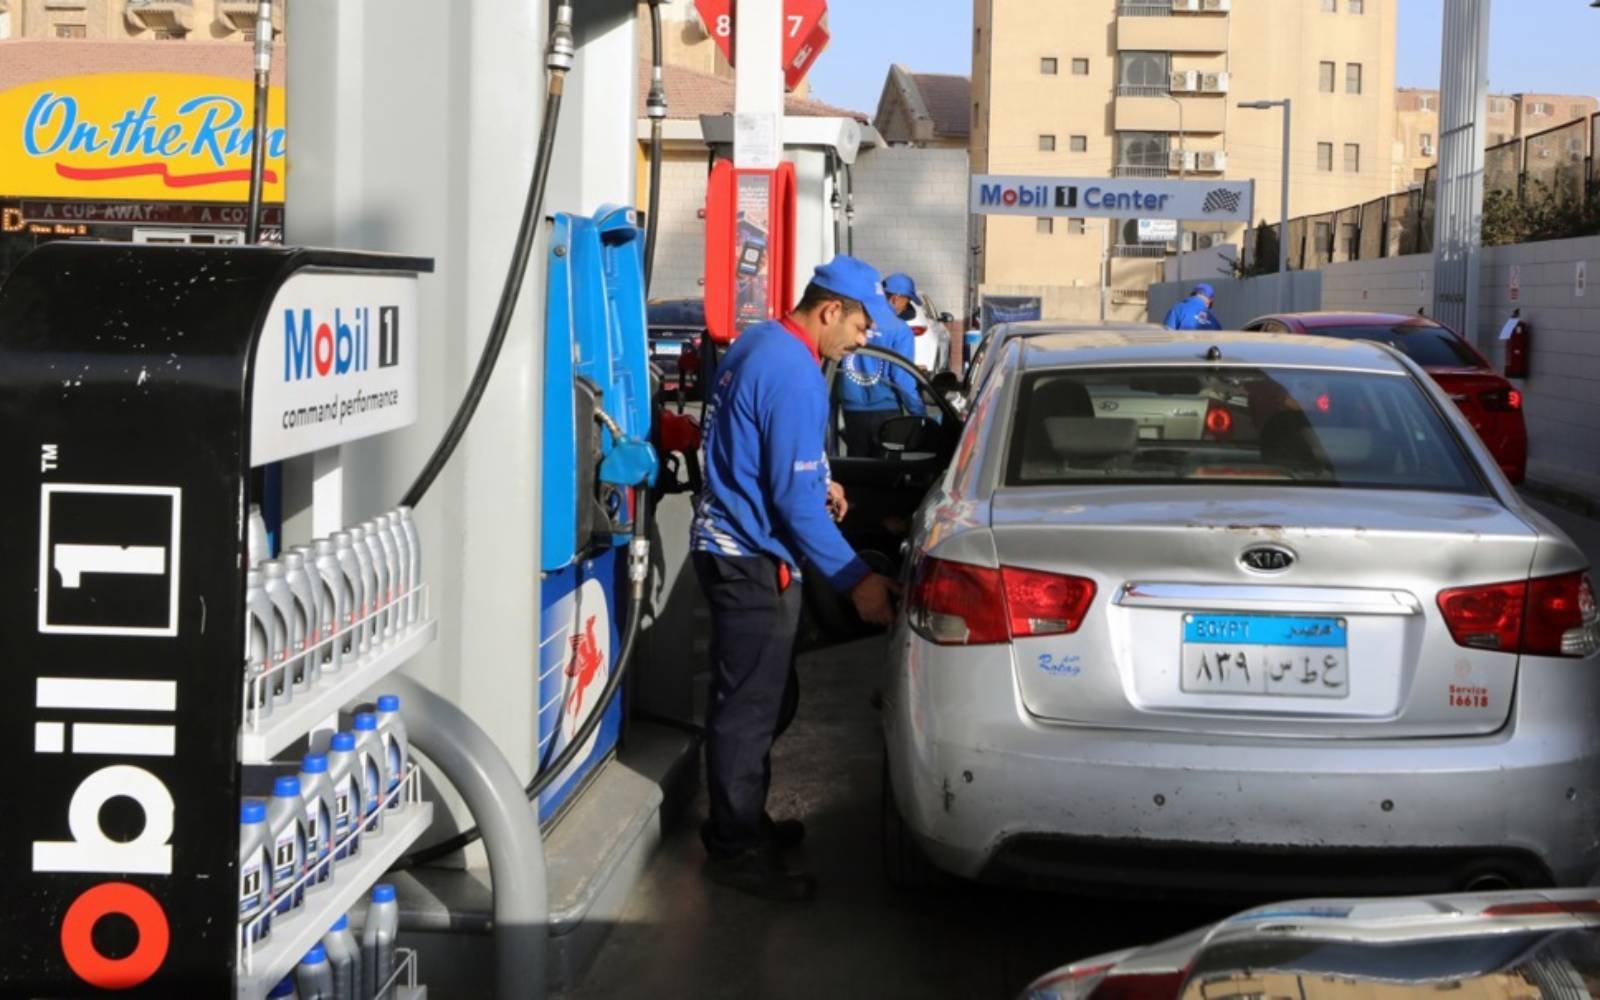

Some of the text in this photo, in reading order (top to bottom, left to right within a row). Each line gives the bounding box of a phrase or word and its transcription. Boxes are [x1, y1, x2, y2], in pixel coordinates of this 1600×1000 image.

[716, 15, 731, 36] 8
[787, 15, 804, 37] 7
[24, 93, 107, 155] On
[110, 96, 188, 156] the
[980, 185, 1048, 207] Mobil
[1084, 187, 1168, 210] Center
[44, 204, 55, 218] A
[62, 204, 97, 219] CUP
[201, 207, 212, 221] A
[285, 307, 369, 382] Mobil
[282, 389, 398, 429] command performance
[41, 444, 58, 472] TM
[1249, 552, 1286, 568] KIA
[1196, 620, 1249, 638] EGYPT
[1283, 623, 1332, 639] مصر
[1196, 652, 1250, 683] ٨٣٩
[1449, 684, 1488, 695] Service
[1449, 695, 1488, 708] 16618
